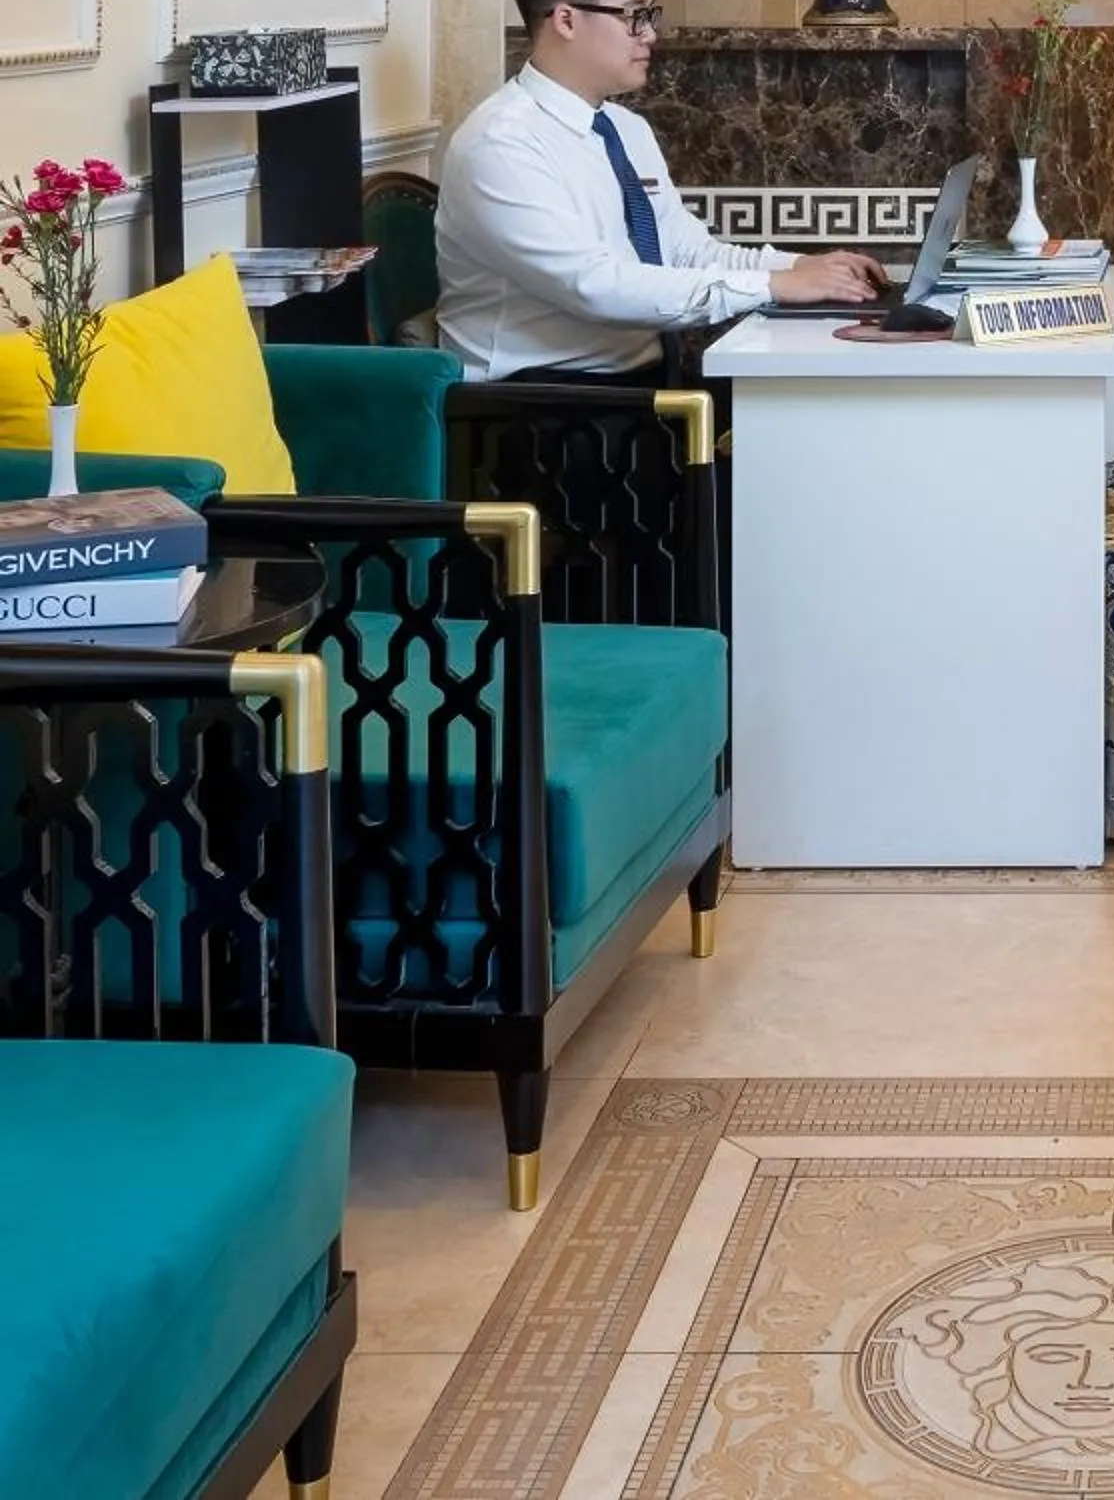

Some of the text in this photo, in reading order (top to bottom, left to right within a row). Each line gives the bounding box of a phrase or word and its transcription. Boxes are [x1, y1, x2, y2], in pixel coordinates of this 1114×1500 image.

[976, 294, 1107, 334] TOUR INFORMATION
[0, 538, 155, 575] GIVENCHY
